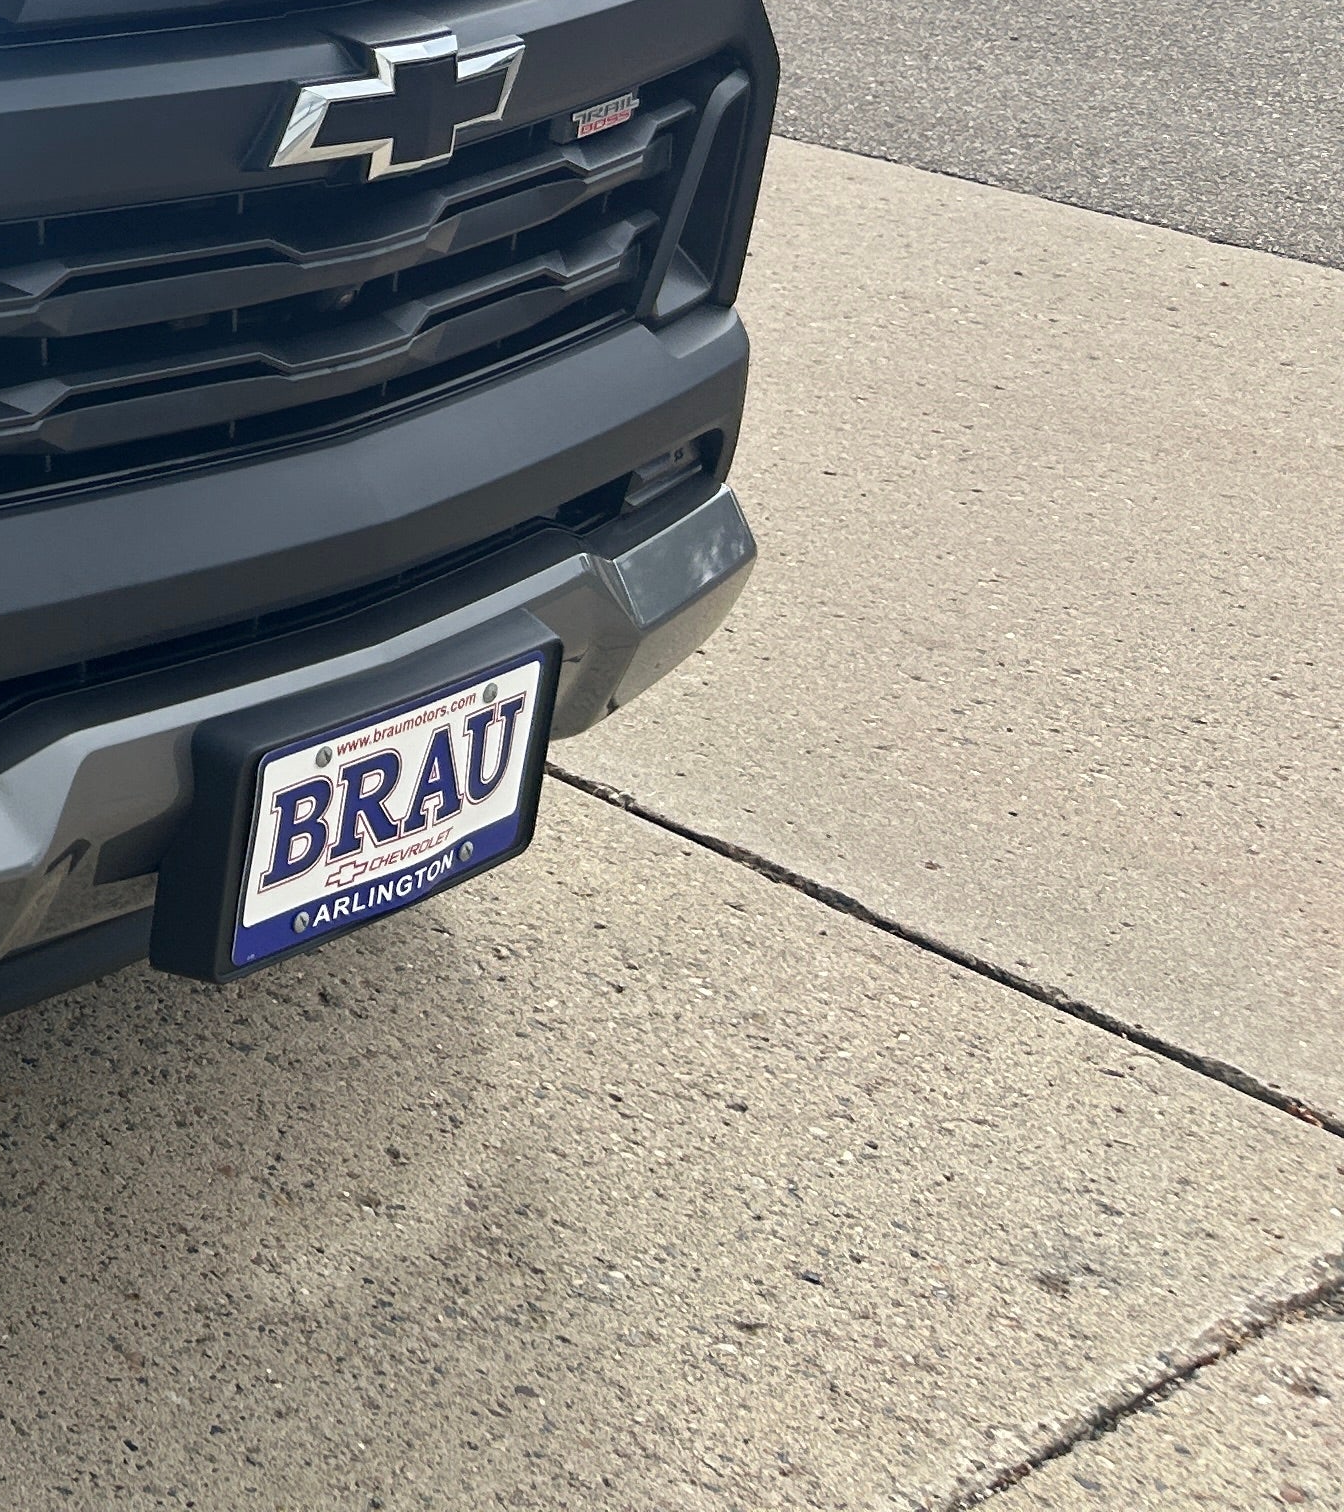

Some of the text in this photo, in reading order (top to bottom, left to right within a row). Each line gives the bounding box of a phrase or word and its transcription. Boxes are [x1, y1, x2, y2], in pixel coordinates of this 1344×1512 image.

[572, 92, 640, 125] TRAIL
[578, 109, 631, 137] BOSS
[336, 692, 477, 757] www.braumotors.com
[257, 691, 527, 894] BRAU
[368, 826, 454, 871] CHEVROLET
[312, 849, 454, 927] ARLINGTON
